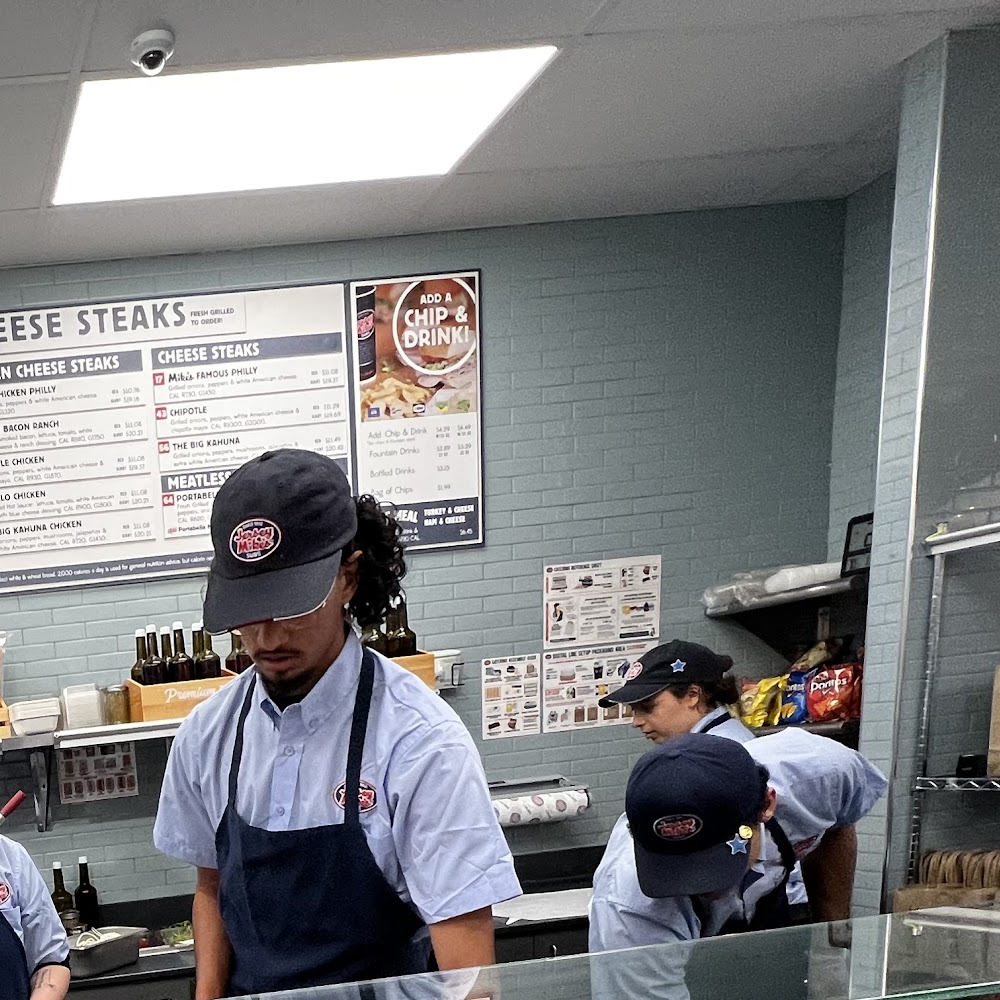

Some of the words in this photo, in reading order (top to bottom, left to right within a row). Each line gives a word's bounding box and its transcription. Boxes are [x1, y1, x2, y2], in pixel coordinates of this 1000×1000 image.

[420, 293, 442, 305] ADD
[445, 292, 453, 302] A
[77, 301, 186, 336] STEAKS
[190, 309, 209, 318] FRESH
[210, 307, 235, 316] GRILLED
[404, 306, 449, 327] CHIP
[455, 305, 469, 323] &
[404, 325, 469, 349] DRINK!
[157, 347, 208, 364] CHEESE
[211, 342, 260, 360] STEAKS
[15, 360, 67, 378] CHEESE
[70, 355, 120, 373] STEAKS
[196, 369, 229, 380] FAMOUS
[231, 366, 258, 377] PHILLY
[29, 385, 57, 395] PHILLY
[169, 406, 208, 417] CHIPOTLE
[3, 423, 30, 433] BACON
[32, 420, 60, 430] RANCH
[368, 431, 382, 439] Add
[385, 429, 401, 438] Chip
[402, 428, 408, 436] &
[410, 427, 427, 436] Drink
[172, 442, 189, 451] THE
[190, 440, 204, 449] BIG
[206, 437, 241, 448] KAHUNA
[369, 448, 398, 458] Fountain
[400, 447, 421, 456] Drinks
[11, 456, 45, 466] CHICKEN
[370, 468, 393, 478] Bottled
[395, 467, 416, 476] Drinks
[13, 490, 46, 501] CHICKEN
[385, 486, 393, 495] of
[394, 486, 414, 495] Chips
[423, 507, 447, 517] TURKEY
[453, 505, 475, 514] CHEESE
[13, 523, 48, 534] KAHUNA
[49, 520, 83, 531] CHICKEN
[423, 519, 438, 527] HAM
[445, 515, 466, 524] CHEESE
[234, 527, 274, 542] Jersey
[810, 678, 847, 694] Doritos
[164, 687, 217, 704] Premium
